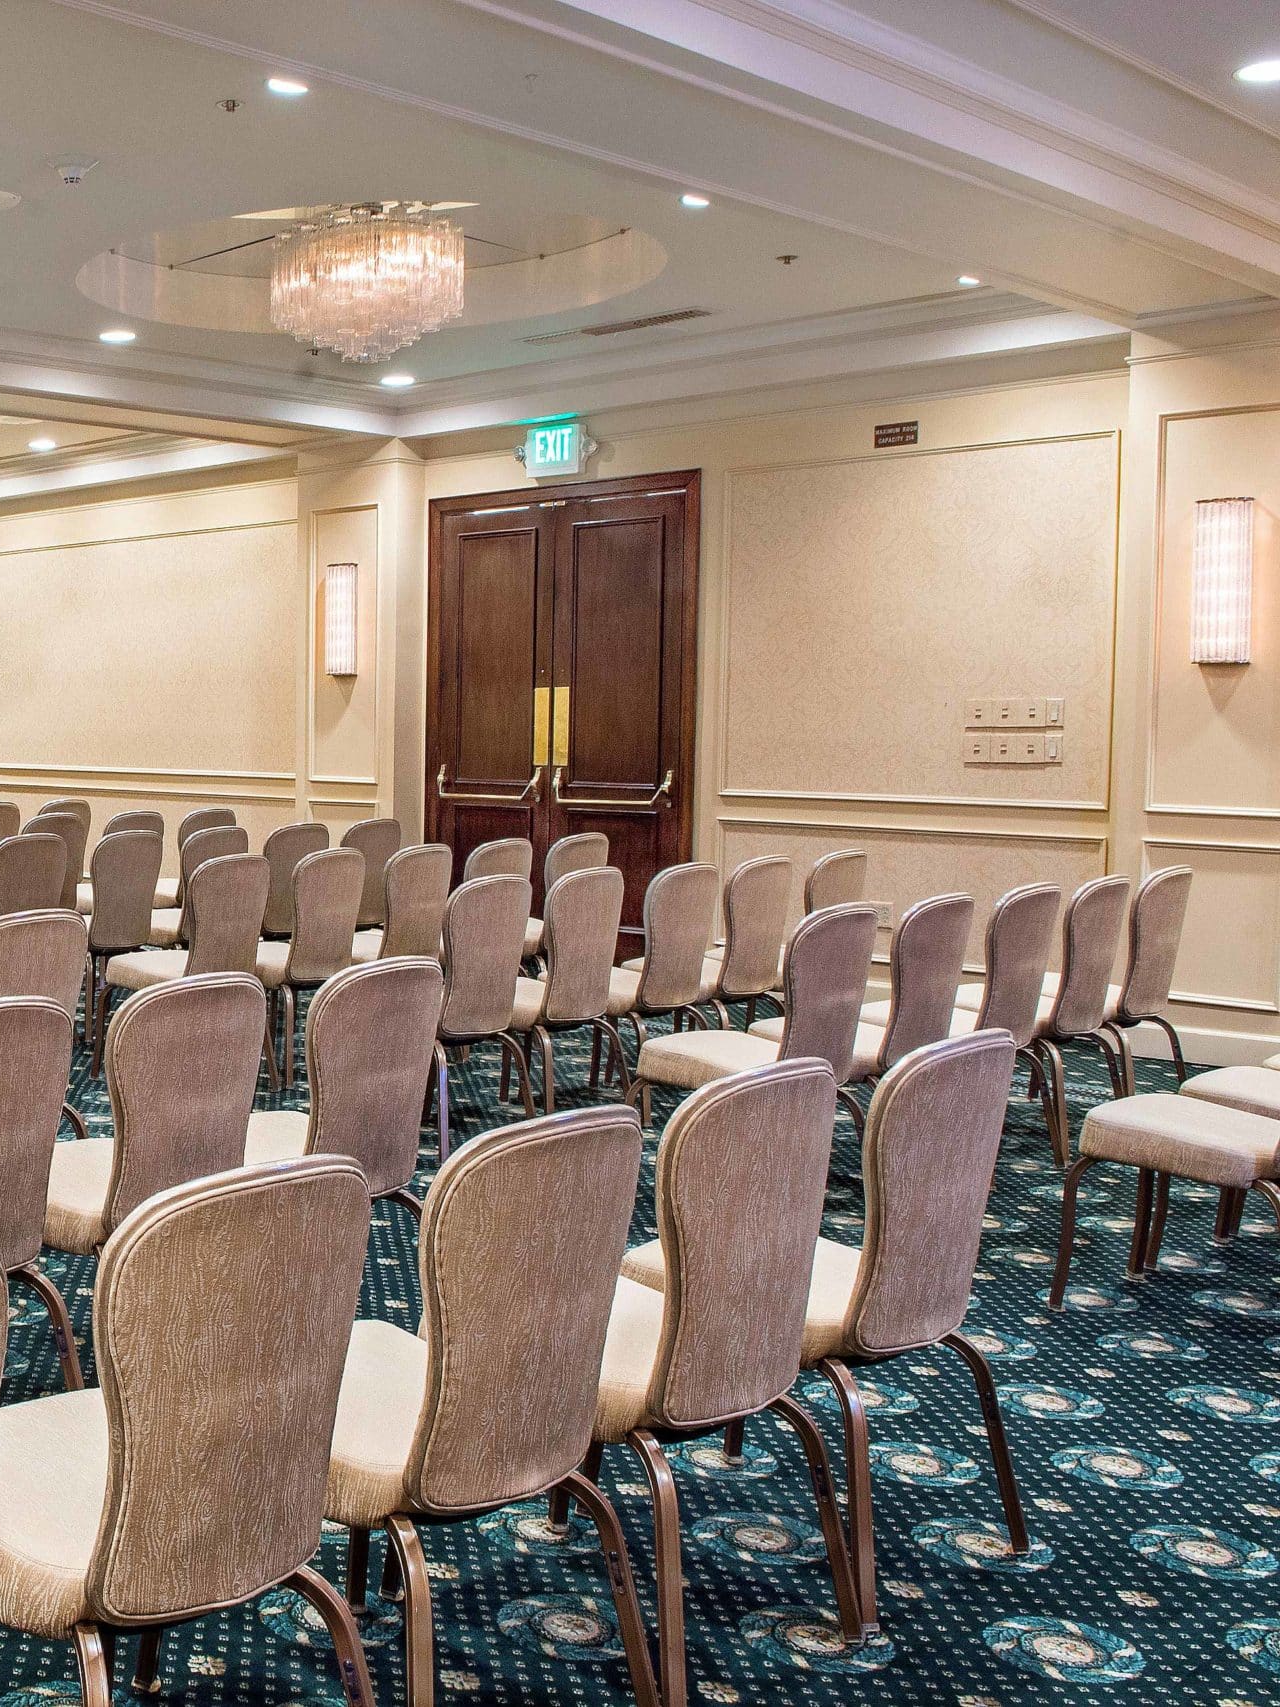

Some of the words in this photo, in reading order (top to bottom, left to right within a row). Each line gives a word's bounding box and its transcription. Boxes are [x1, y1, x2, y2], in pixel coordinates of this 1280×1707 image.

[875, 427, 901, 435] MAXIMUM
[902, 425, 918, 433] ROOM
[878, 435, 904, 444] CAPACITY
[535, 428, 573, 464] EXIT
